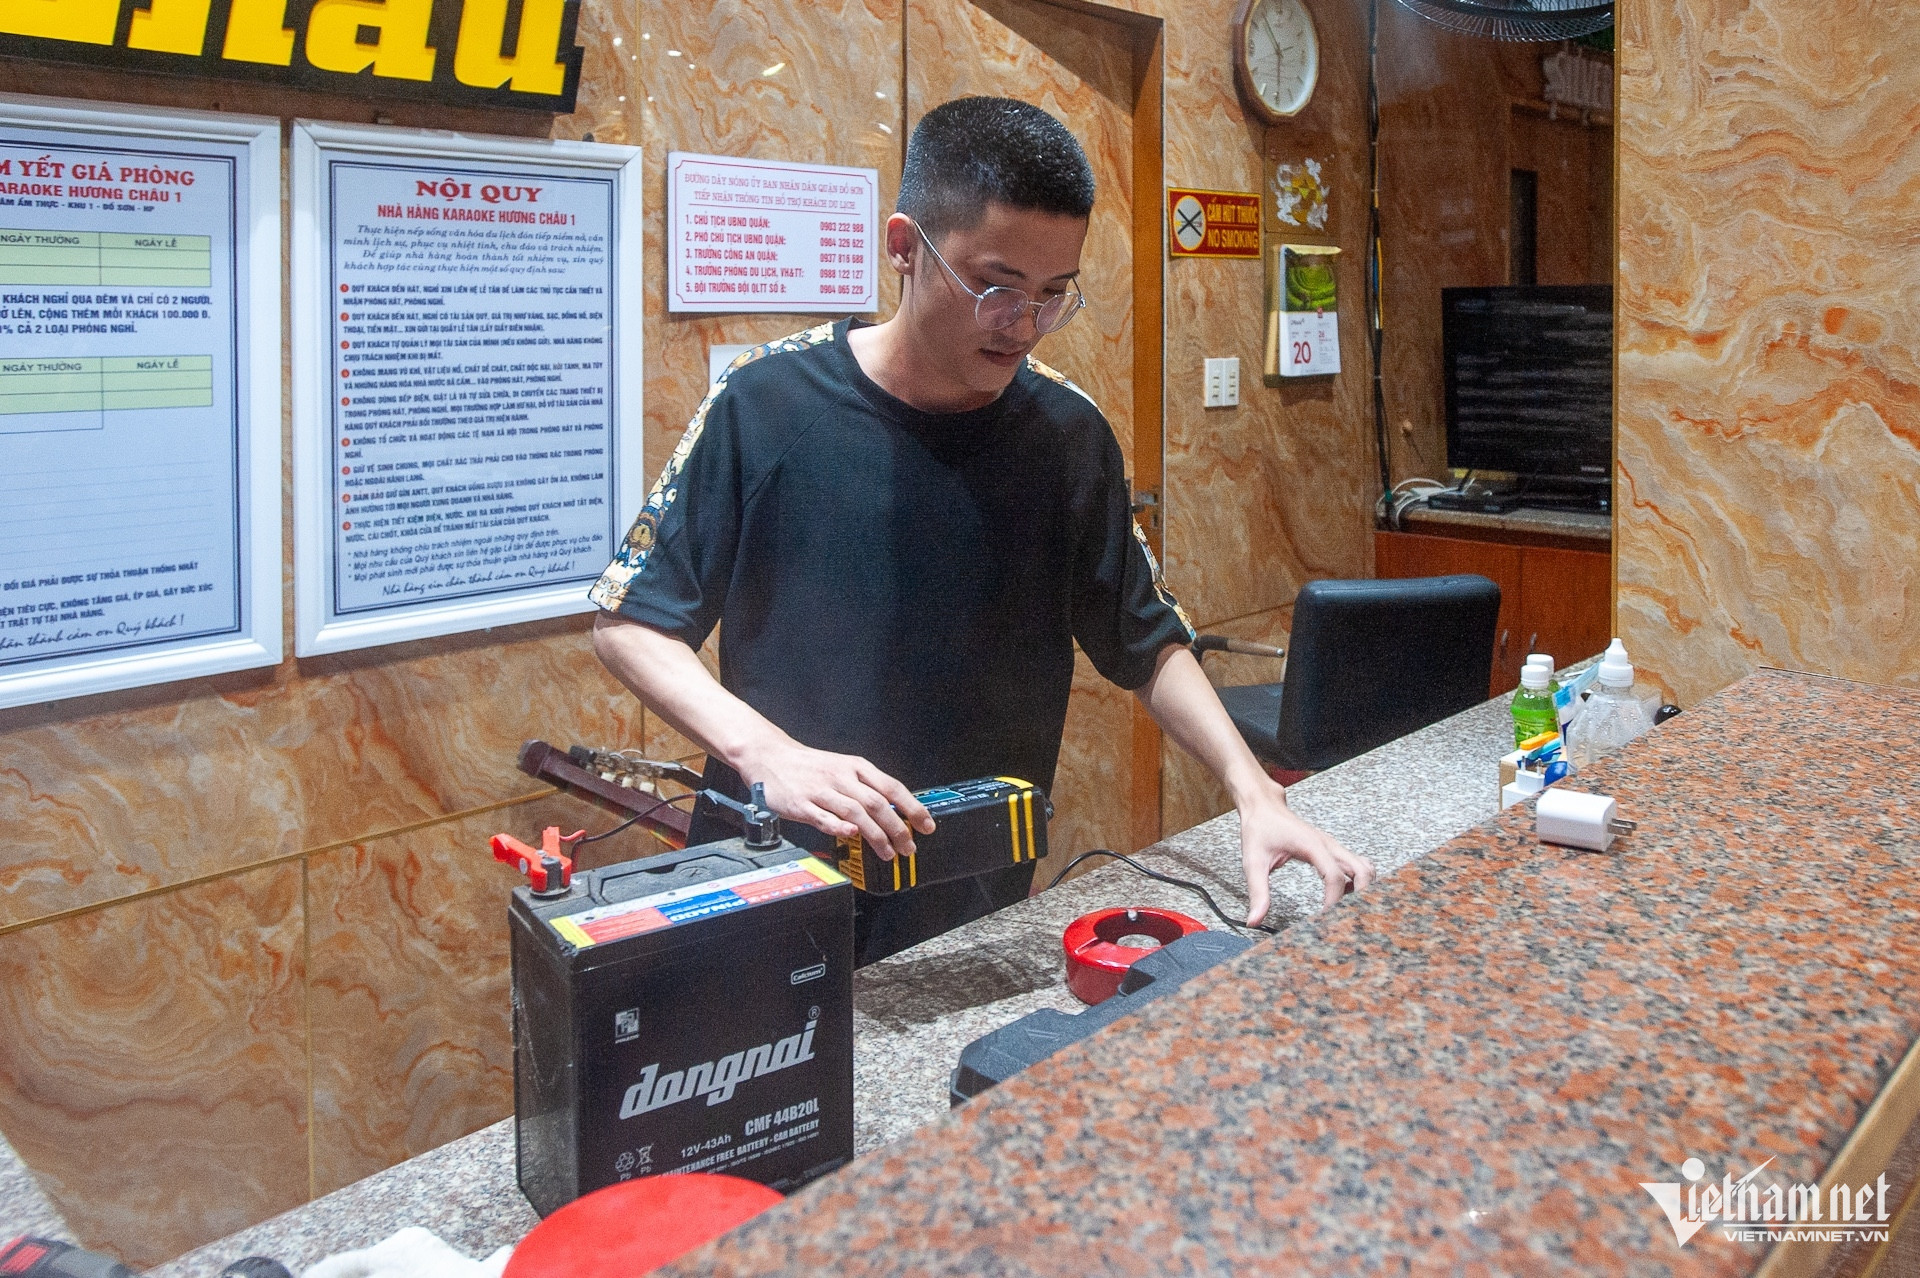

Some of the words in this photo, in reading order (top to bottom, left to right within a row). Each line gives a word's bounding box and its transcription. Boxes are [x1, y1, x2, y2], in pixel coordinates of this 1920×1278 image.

[18, 155, 65, 178] YẾT
[72, 162, 113, 181] GIÁ
[119, 165, 195, 186] PHÒNG
[416, 177, 472, 201] NỘI
[480, 185, 543, 203] QUY
[712, 174, 726, 185] DÂY
[763, 180, 777, 188] BAN
[780, 180, 800, 190] NHÂN
[802, 181, 817, 191] DÂN
[69, 186, 123, 199] HƯƠNG
[129, 188, 169, 202] CHÂU
[175, 192, 181, 202] 1
[762, 196, 773, 204] TIN
[803, 197, 826, 207] KHÁCH
[829, 200, 838, 208] DU
[378, 202, 403, 218] NHÀ
[407, 204, 438, 220] HÀNG
[443, 208, 494, 222] KARAOKE
[498, 210, 535, 224] HƯƠNG
[540, 211, 567, 225] CHÂU
[571, 215, 575, 225] 1
[694, 211, 708, 224] CHỦ
[711, 216, 725, 228] TỊCH
[728, 217, 746, 226] UBND
[839, 223, 850, 232] 232
[1, 235, 31, 243] NGÀY
[35, 235, 80, 245] THƯỜNG
[135, 239, 163, 247] NGÀY
[165, 238, 177, 247] LỄ
[686, 231, 692, 241] 2.
[694, 230, 708, 242] PHÓ
[711, 228, 724, 242] CHỦ
[727, 233, 741, 245] TỊCH
[744, 234, 762, 244] UBND
[1208, 229, 1220, 247] NO
[1222, 229, 1258, 248] SMOKING
[686, 248, 692, 258] 3.
[694, 245, 721, 259] TRƯỞNG
[724, 248, 742, 260] CÔNG
[745, 250, 754, 260] AN
[686, 266, 692, 275] 4.
[694, 262, 721, 275] TRƯỞNG
[724, 264, 747, 276] PHÒNG
[750, 267, 759, 276] DU
[839, 270, 850, 278] 122
[853, 270, 863, 278] 127
[686, 283, 692, 292] 5.
[694, 281, 705, 294] ĐỘI
[709, 279, 735, 292] TRƯỞNG
[738, 281, 749, 295] ĐỘI
[752, 284, 767, 293] QLTT
[769, 281, 778, 293] SỐ
[3, 293, 39, 304] KHÁCH
[43, 292, 68, 304] NGHỈ
[72, 295, 92, 304] QUA
[96, 294, 118, 304] ĐÊM
[121, 294, 133, 304] VÀ
[138, 293, 153, 304] CHỈ
[157, 294, 170, 304] CÓ
[39, 308, 68, 320] CỘNG
[72, 308, 99, 318] THÊM
[103, 307, 122, 318] MỖI
[126, 309, 158, 318] KHÁCH
[163, 310, 199, 318] 100.000
[18, 321, 32, 334] CẢ
[35, 325, 42, 333] 2
[46, 325, 68, 335] LOẠI
[72, 323, 107, 334] PHÒNG
[111, 321, 137, 333] NGHỈ.
[1294, 341, 1311, 364] 20
[3, 364, 33, 372] NGÀY
[37, 362, 82, 371] THƯỜNG
[137, 361, 164, 370] NGÀY
[167, 359, 178, 369] LỄ
[28, 630, 63, 646] thành
[117, 621, 141, 636] Quý
[145, 615, 176, 630] khách
[619, 1020, 818, 1120] dongnai
[745, 1114, 772, 1136] CMF
[773, 1098, 819, 1127] 44B20L
[716, 1150, 735, 1162] FREE
[736, 1138, 769, 1156] BATTERY
[774, 1132, 788, 1143] CAR
[789, 1119, 819, 1138] BATTERY
